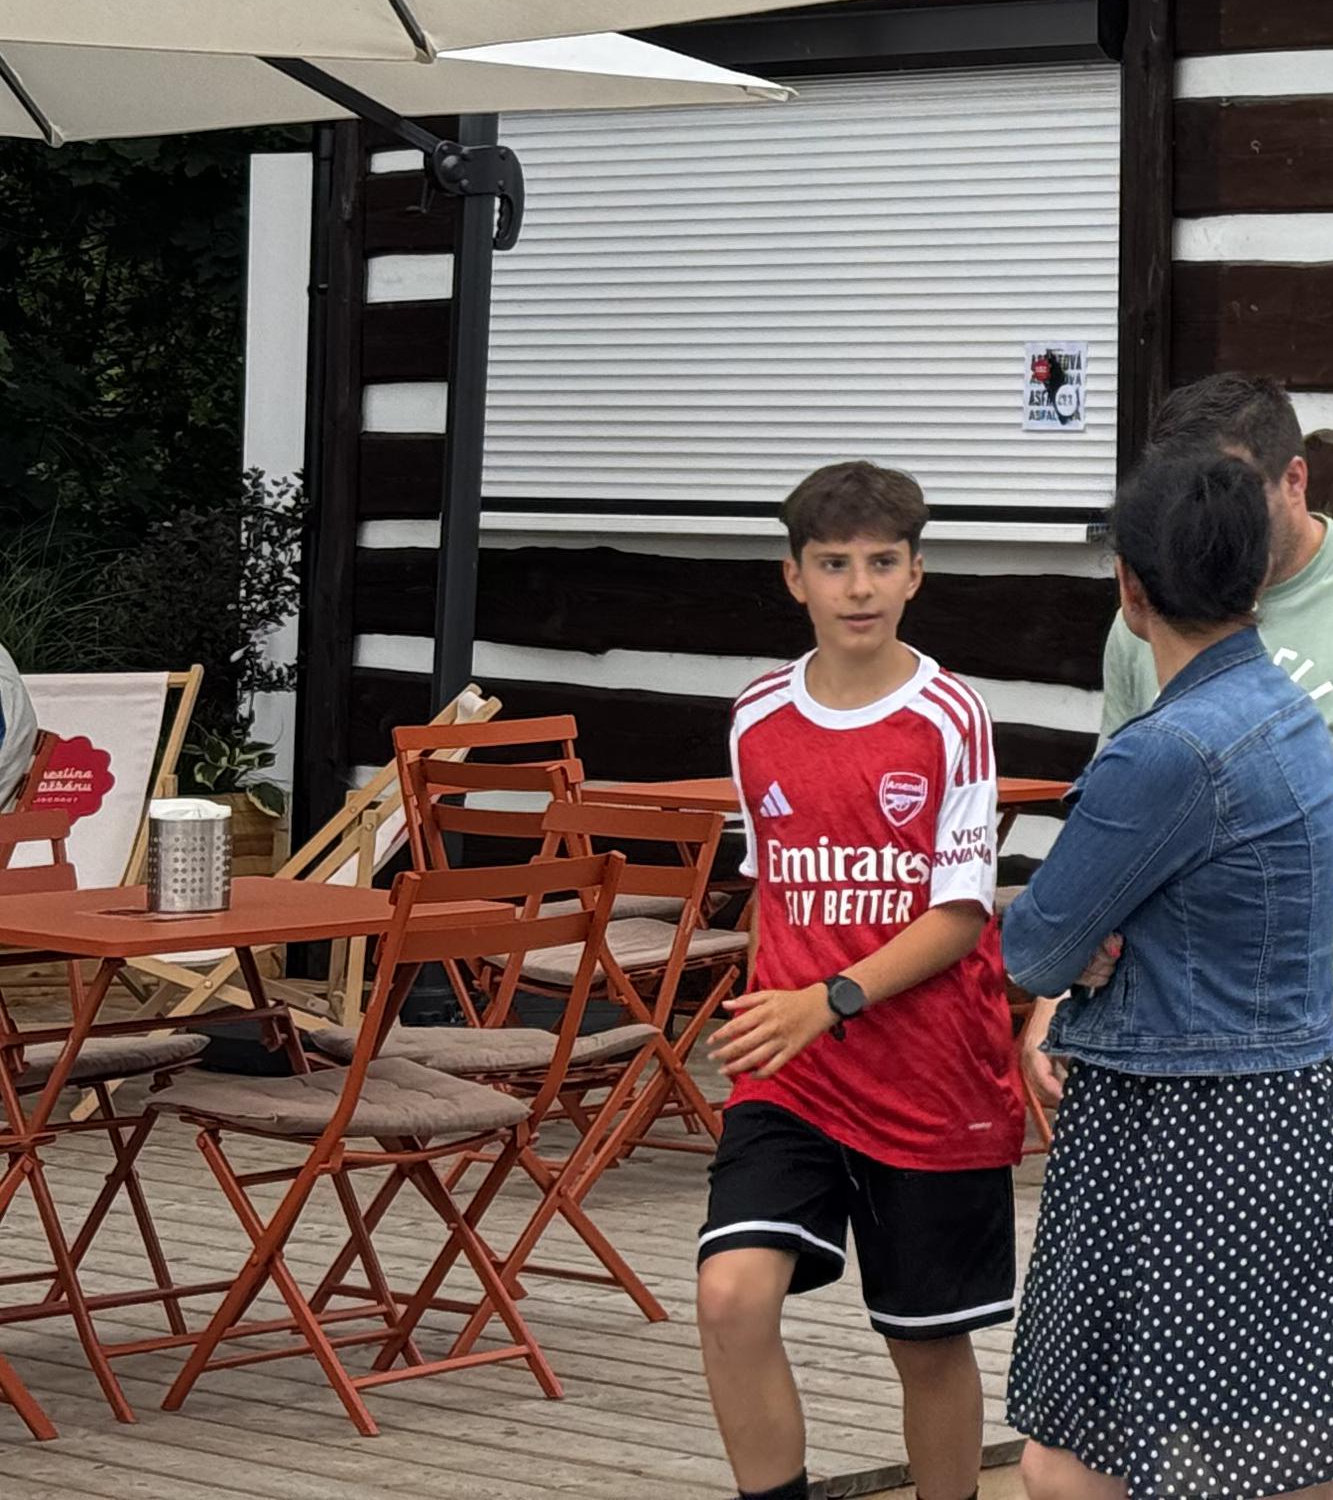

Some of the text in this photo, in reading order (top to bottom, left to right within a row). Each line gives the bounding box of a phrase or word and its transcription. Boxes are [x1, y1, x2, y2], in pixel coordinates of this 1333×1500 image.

[767, 835, 931, 885] Emirates
[785, 889, 914, 926] FLY BETTER
